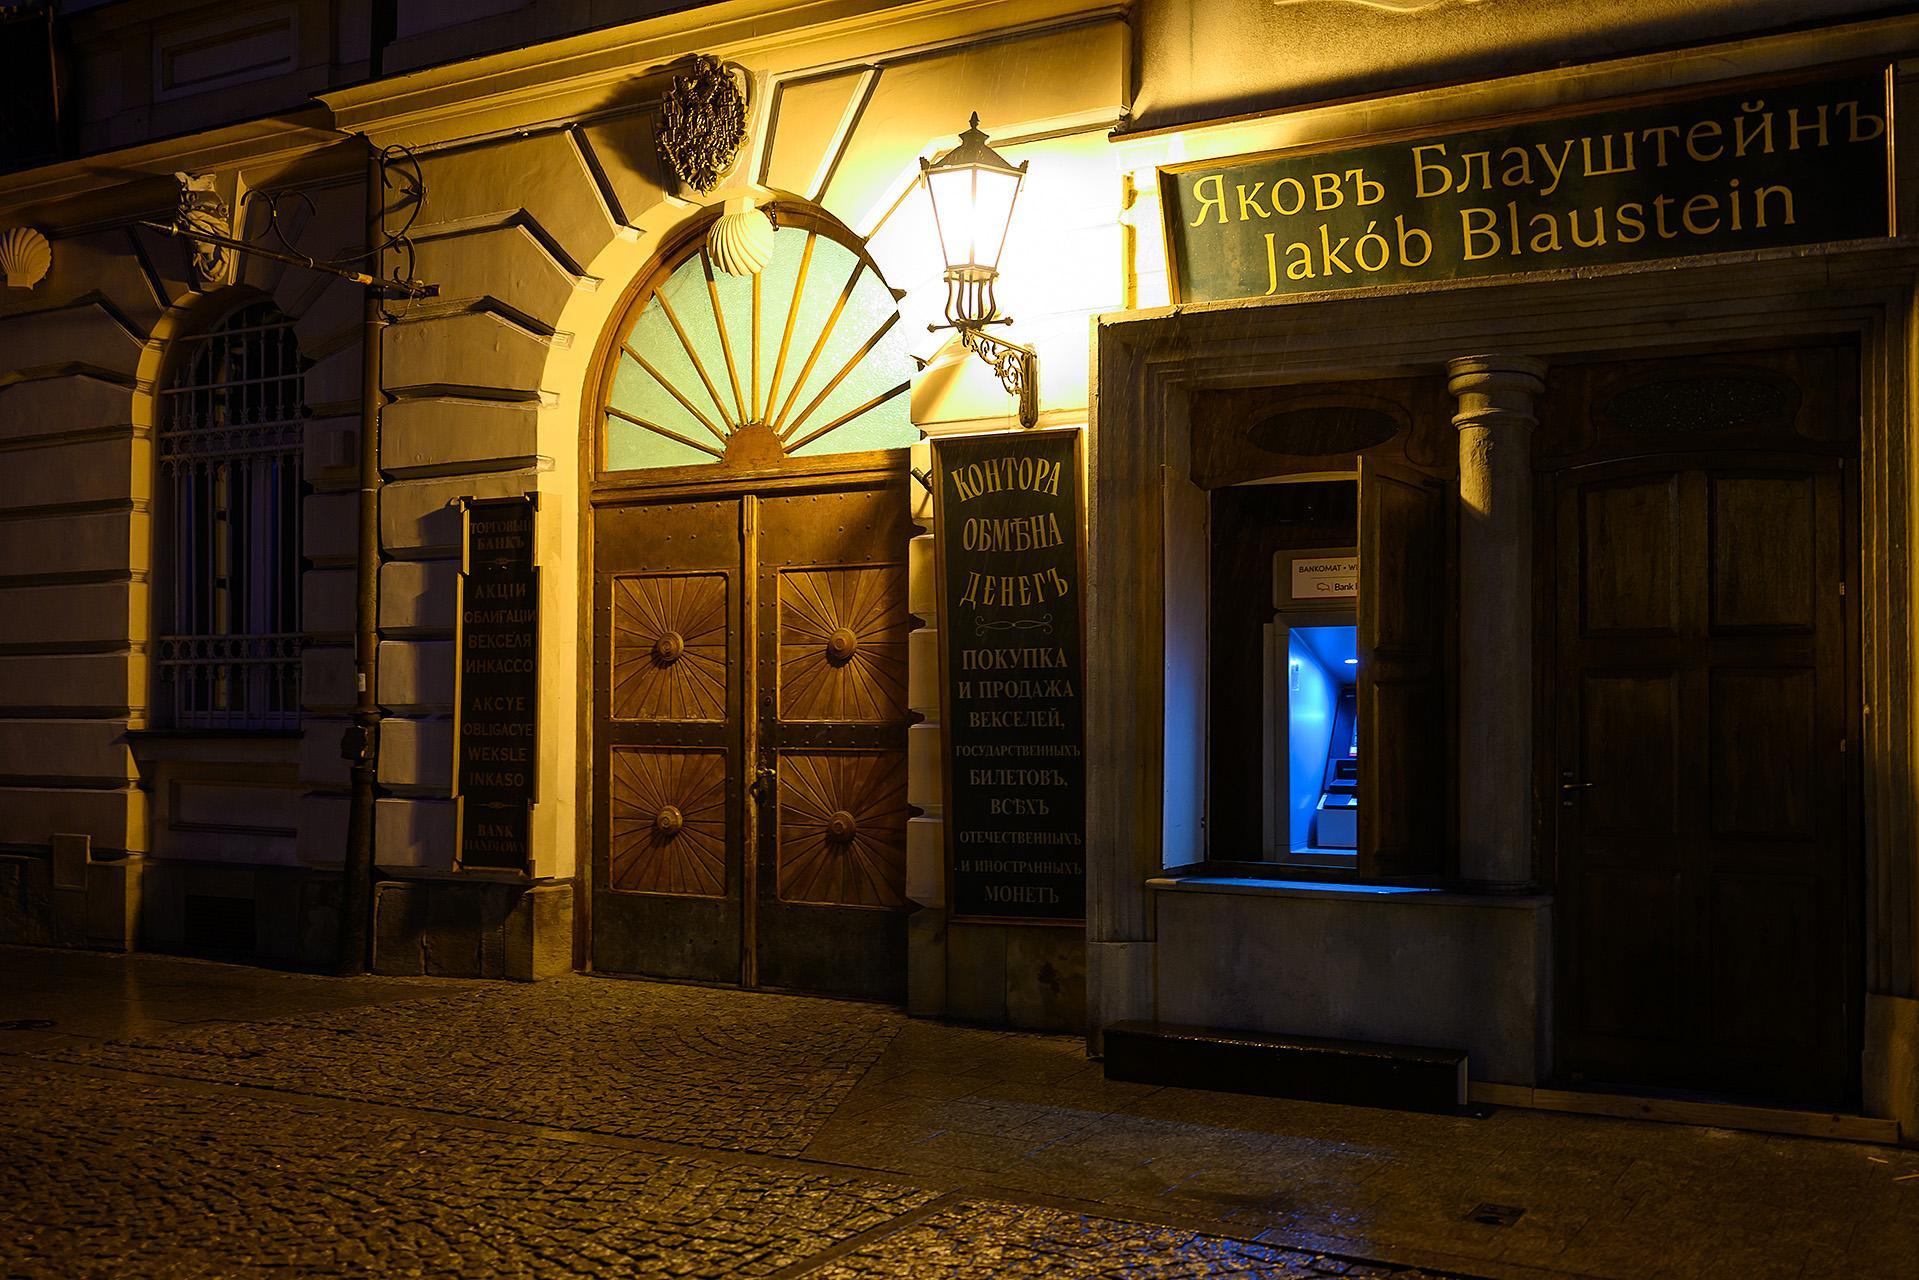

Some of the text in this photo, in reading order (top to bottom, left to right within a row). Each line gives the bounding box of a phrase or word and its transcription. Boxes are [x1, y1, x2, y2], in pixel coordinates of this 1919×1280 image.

[1190, 98, 1886, 228] Яковъ Блауштейнъ
[1264, 184, 1797, 296] Jakób Blaustein
[951, 456, 1061, 503] КОНТОРА
[962, 512, 1065, 552] ОБМѢНА
[1299, 564, 1341, 573] BANKOMAT
[959, 566, 1069, 610] ДЕНЕГЪ
[1334, 583, 1354, 591] Bank
[468, 633, 532, 649] ВЕКСЕЛЯ
[465, 658, 534, 674] ИНКАССО
[962, 647, 1069, 670] ПОКУПКА
[958, 679, 1075, 700] И ПРОДАЖА
[471, 697, 526, 712] AKCYE
[463, 722, 534, 737] OBLIGACYE
[468, 745, 528, 762] WEKSLE
[956, 744, 1081, 758] ГОСУДАРСТВЕННЫХЪ
[469, 771, 525, 788] INKASO
[477, 823, 513, 838] BANK
[959, 830, 1081, 846] ОТЕЧЕСТВЕННЫХЪ
[984, 885, 1060, 904] МОНЕТЪ
